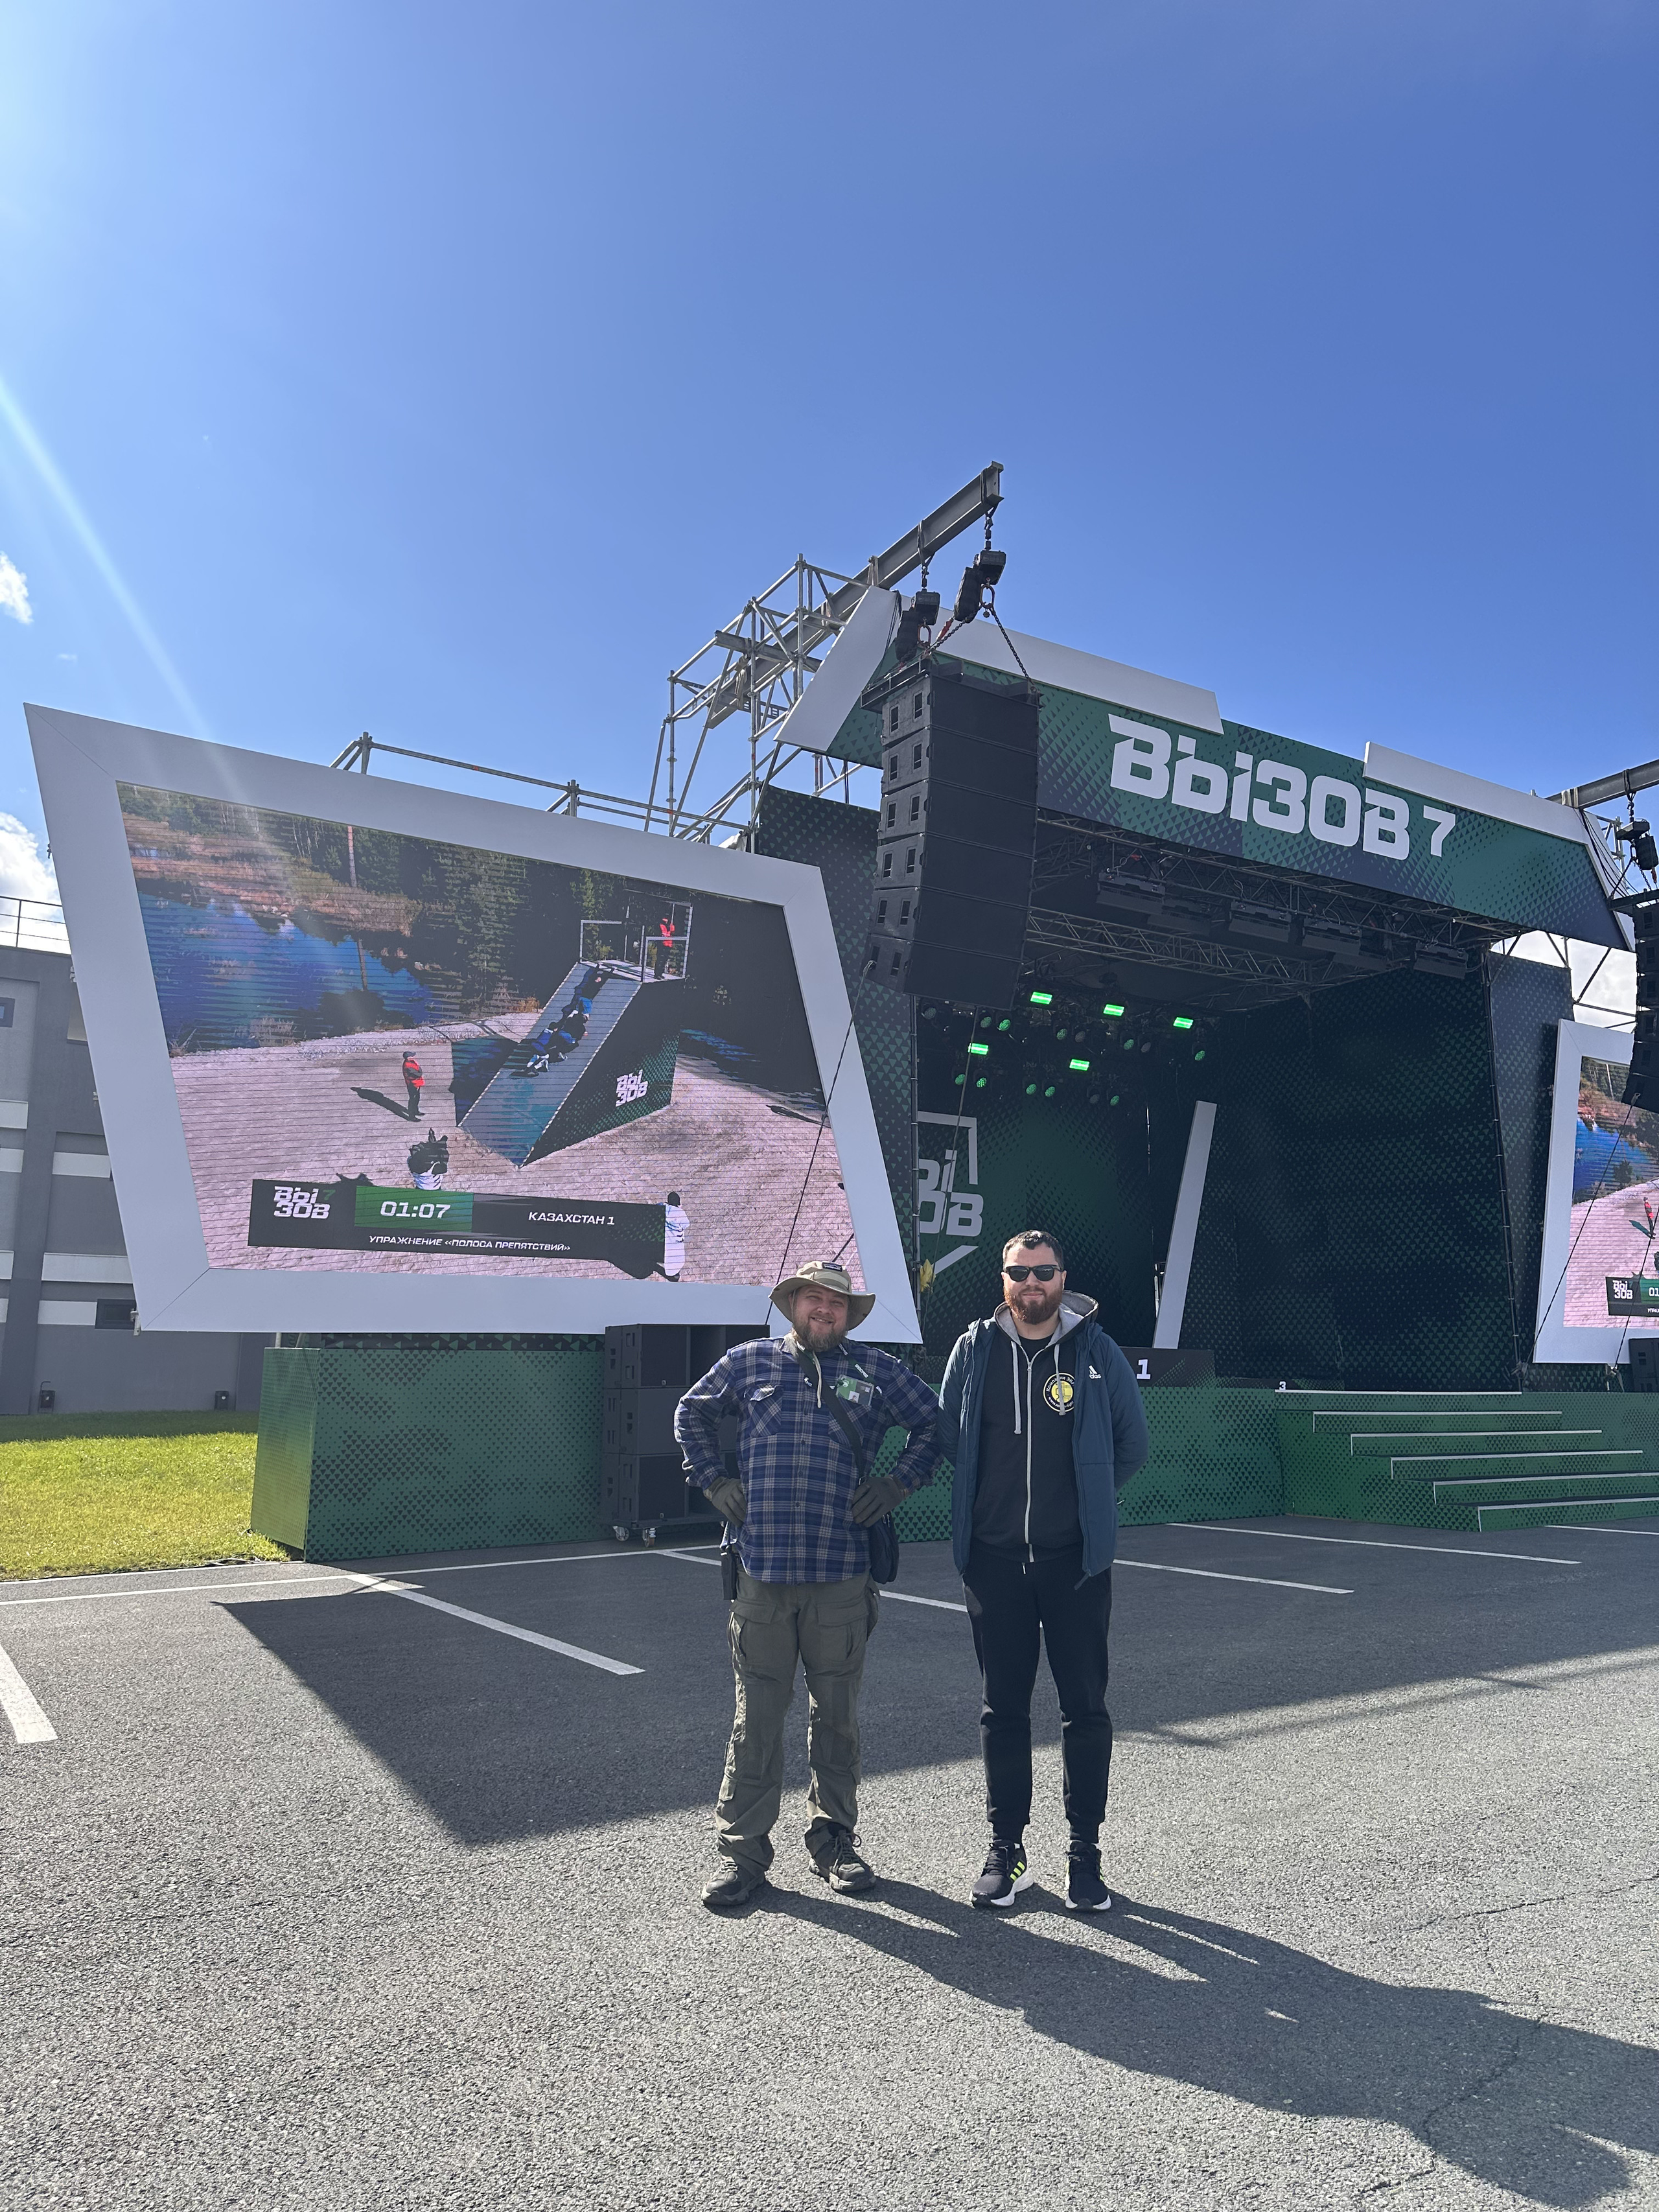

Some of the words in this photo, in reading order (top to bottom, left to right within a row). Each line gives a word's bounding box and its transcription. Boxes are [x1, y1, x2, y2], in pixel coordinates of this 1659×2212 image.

[1423, 804, 1456, 857] 7
[380, 1201, 451, 1219] 01:07
[528, 1211, 605, 1225] КАЗАХСТАН
[607, 1216, 615, 1225] 1
[918, 1190, 984, 1237] ОВ
[369, 1235, 443, 1246] УПРАЖНЕНИЕ
[1136, 1358, 1151, 1380] 1
[1279, 1381, 1286, 1390] 3
